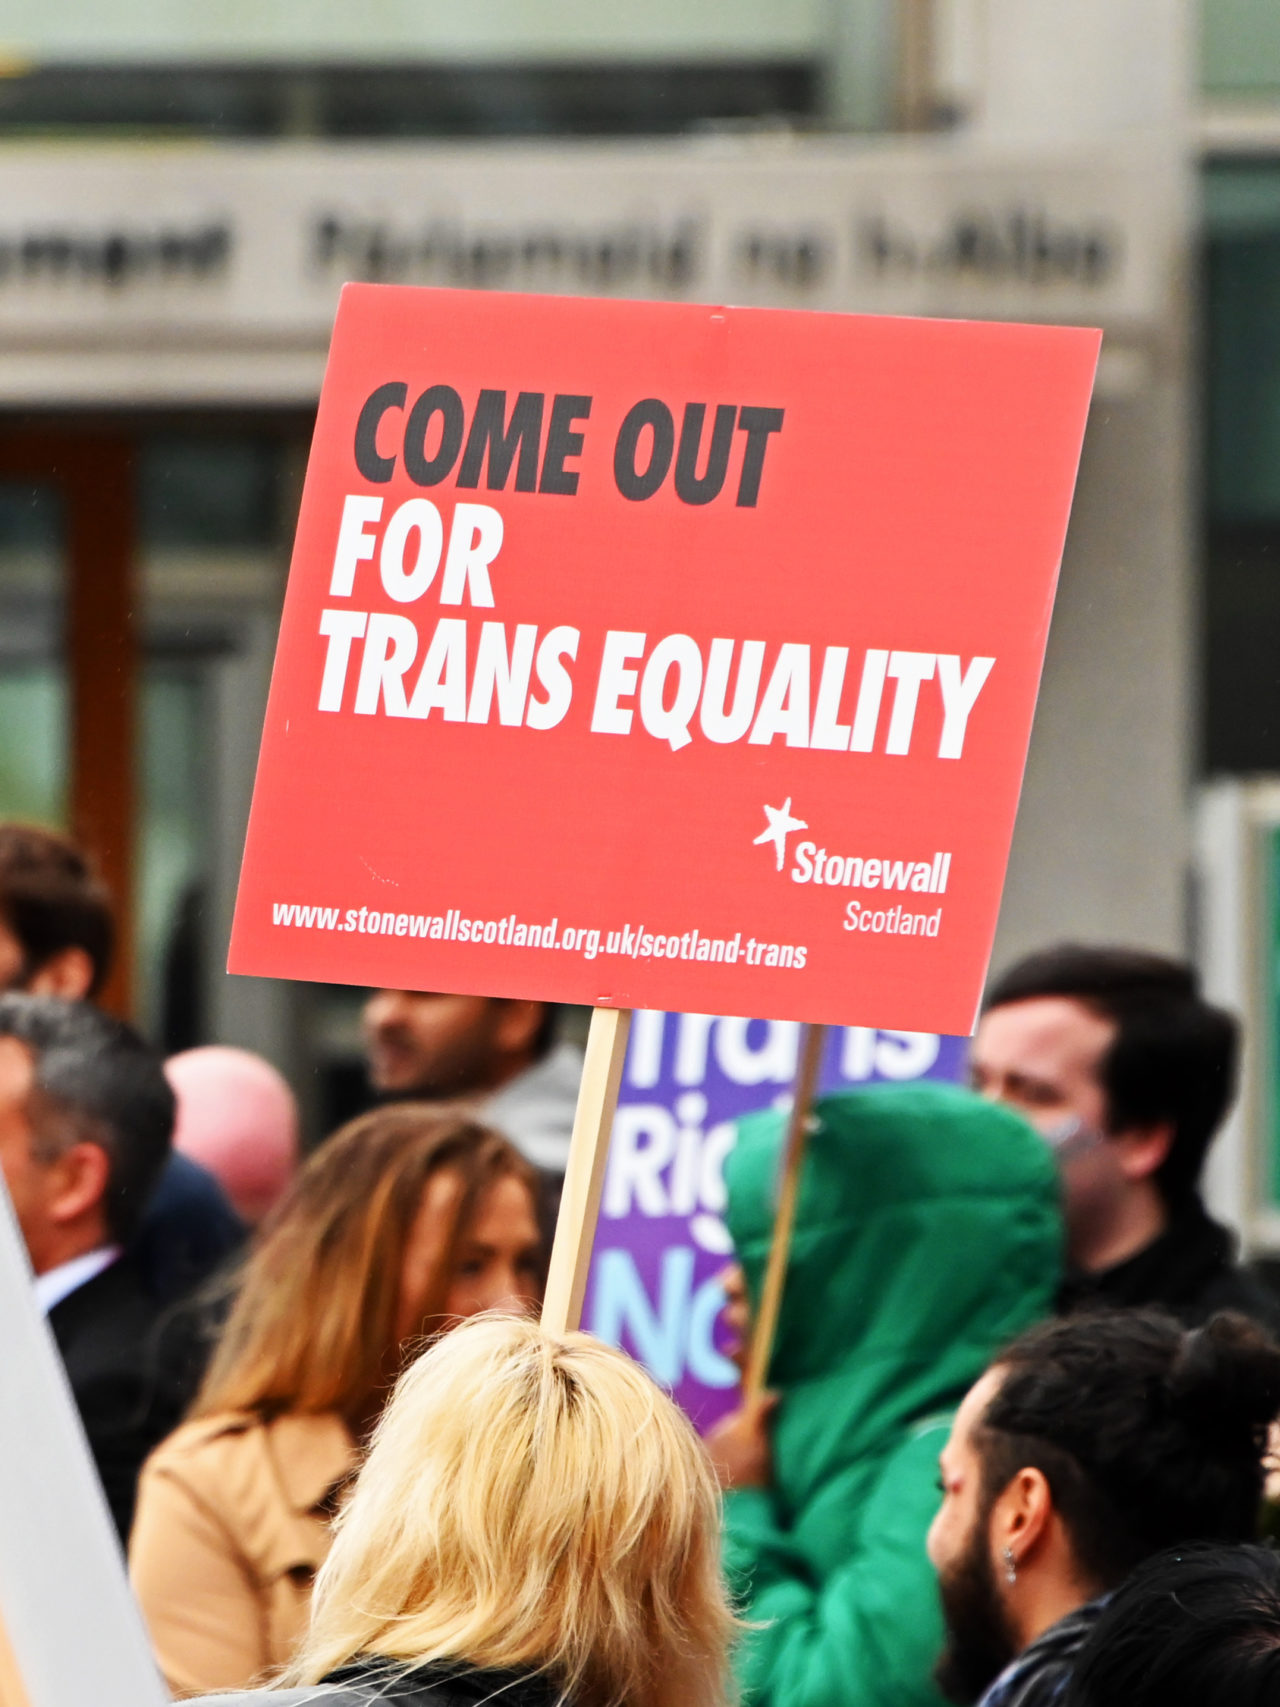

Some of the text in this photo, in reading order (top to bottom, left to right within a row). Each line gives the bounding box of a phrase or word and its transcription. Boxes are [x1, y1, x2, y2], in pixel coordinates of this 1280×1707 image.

[353, 381, 785, 509] COME OUT
[328, 494, 504, 608] FOR
[318, 608, 997, 759] TRANS EQUALITY
[790, 841, 952, 894] Stonewall
[271, 901, 808, 970] www.stonewallscotland.org.uk/scotland-trans
[842, 900, 943, 938] Scotland
